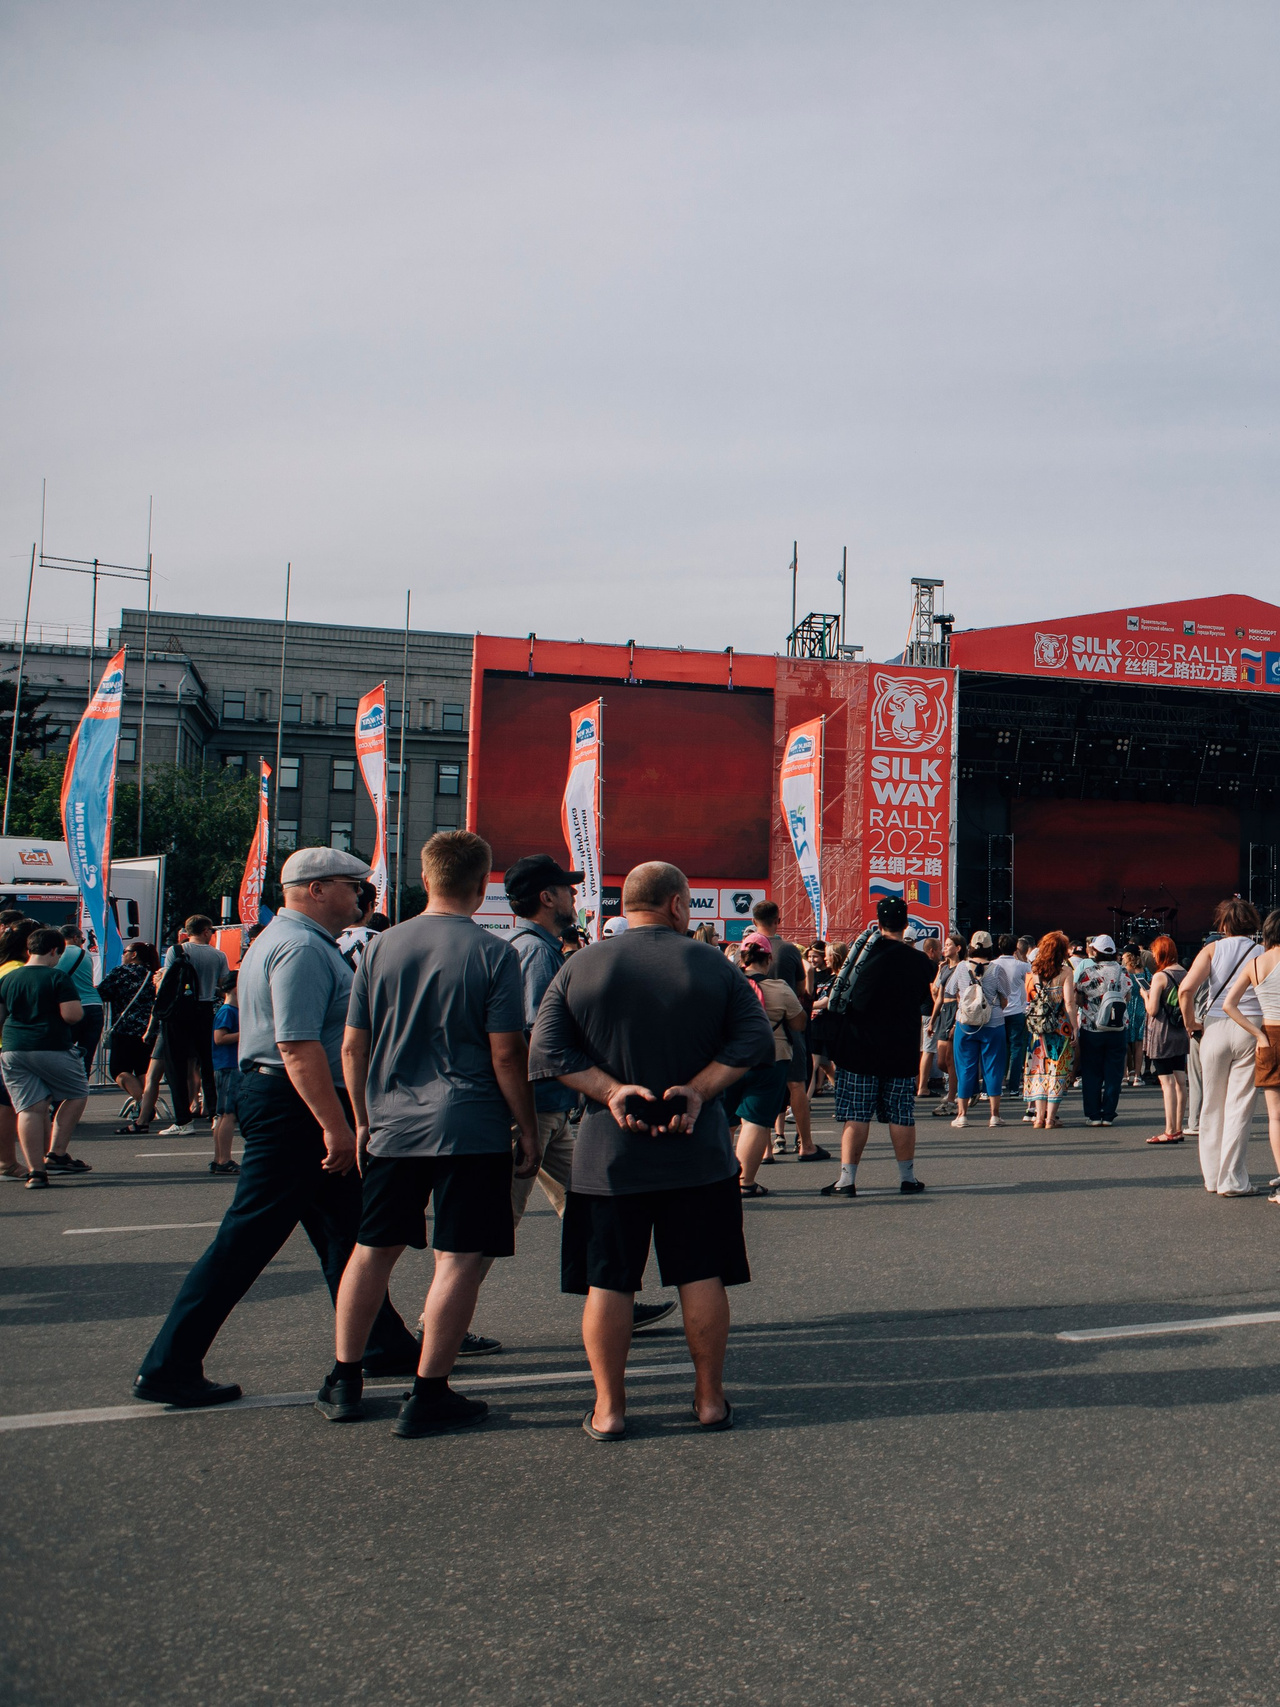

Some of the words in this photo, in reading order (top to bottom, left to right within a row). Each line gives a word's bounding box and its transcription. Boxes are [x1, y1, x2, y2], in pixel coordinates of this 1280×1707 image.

[1248, 628, 1277, 636] МИНСПОРТ
[1072, 636, 1122, 656] SILK
[1125, 640, 1171, 660] 2025
[1173, 644, 1237, 664] RALLY
[1072, 654, 1122, 673] WAY
[1125, 658, 1238, 683] 丝绸之路拉力赛
[871, 755, 943, 782] SILK
[871, 781, 943, 807] WAY
[869, 808, 943, 830] RALLY
[869, 828, 944, 856] 2025
[869, 856, 943, 877] 丝绸之路
[689, 898, 714, 908] MAZ
